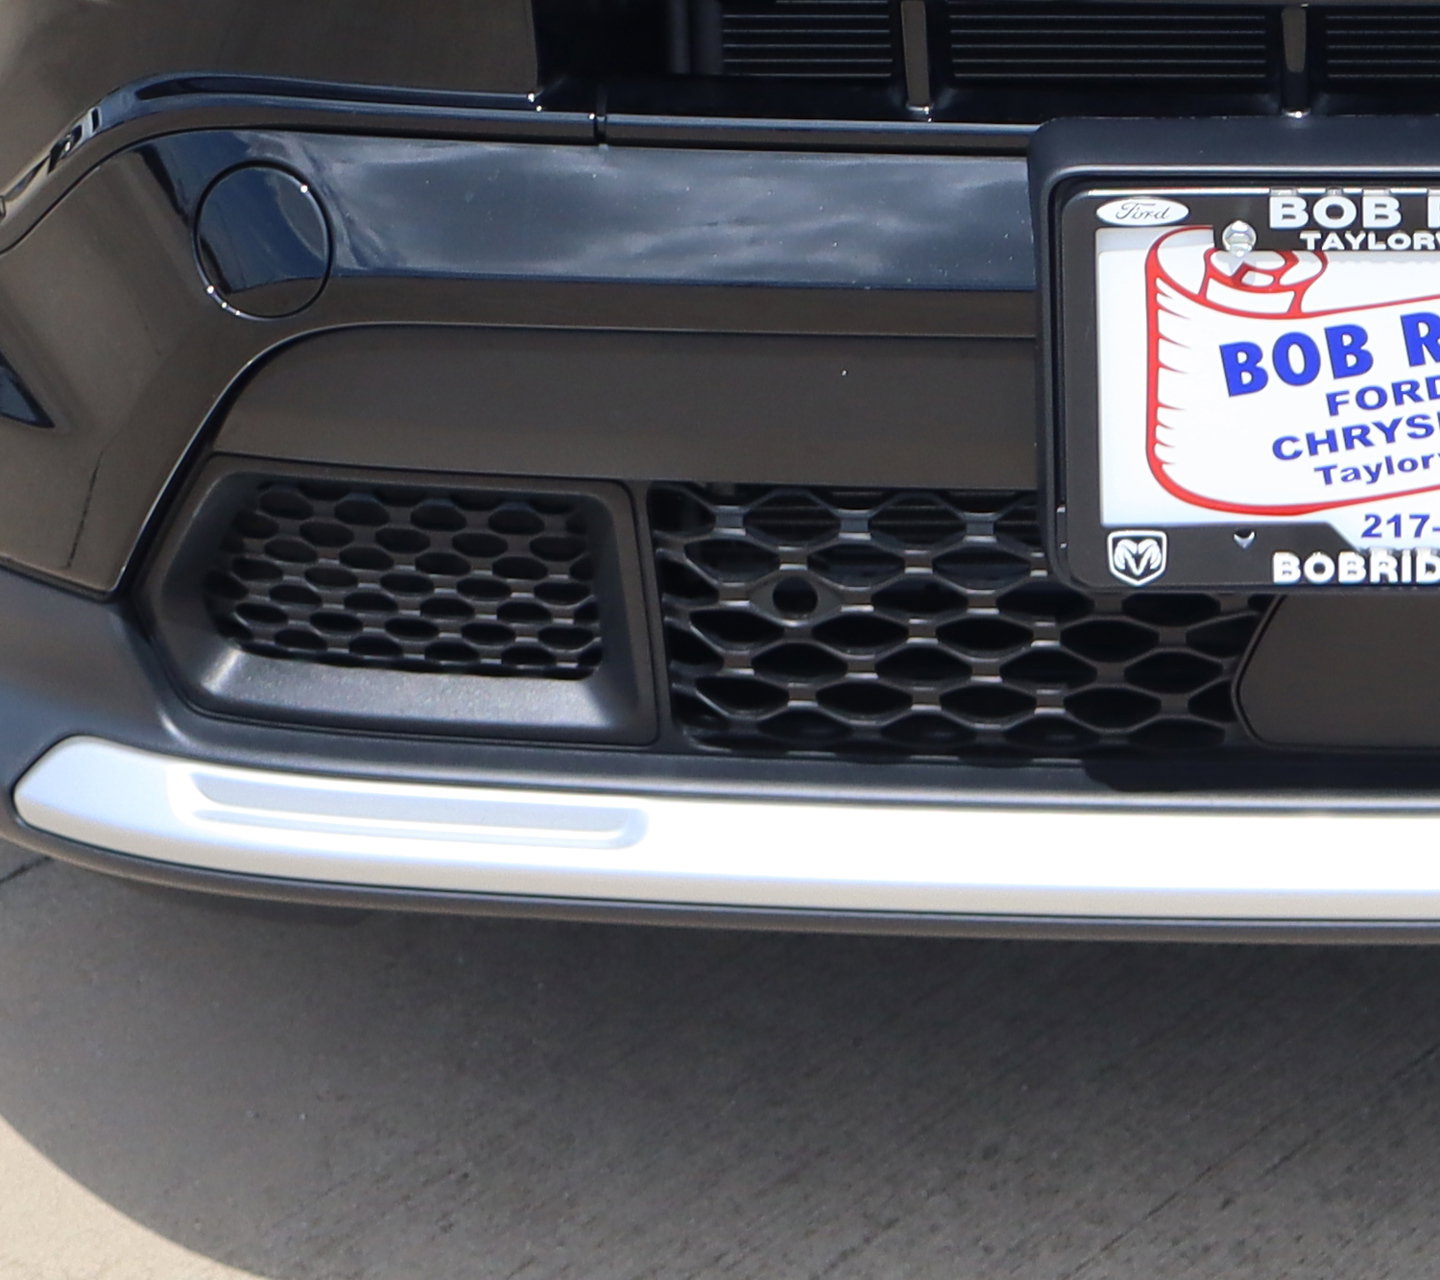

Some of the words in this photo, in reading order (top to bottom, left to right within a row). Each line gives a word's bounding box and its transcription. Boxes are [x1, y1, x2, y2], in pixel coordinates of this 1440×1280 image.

[1115, 200, 1170, 221] Ford
[1269, 195, 1401, 229] BOB
[1218, 323, 1374, 398] BOB
